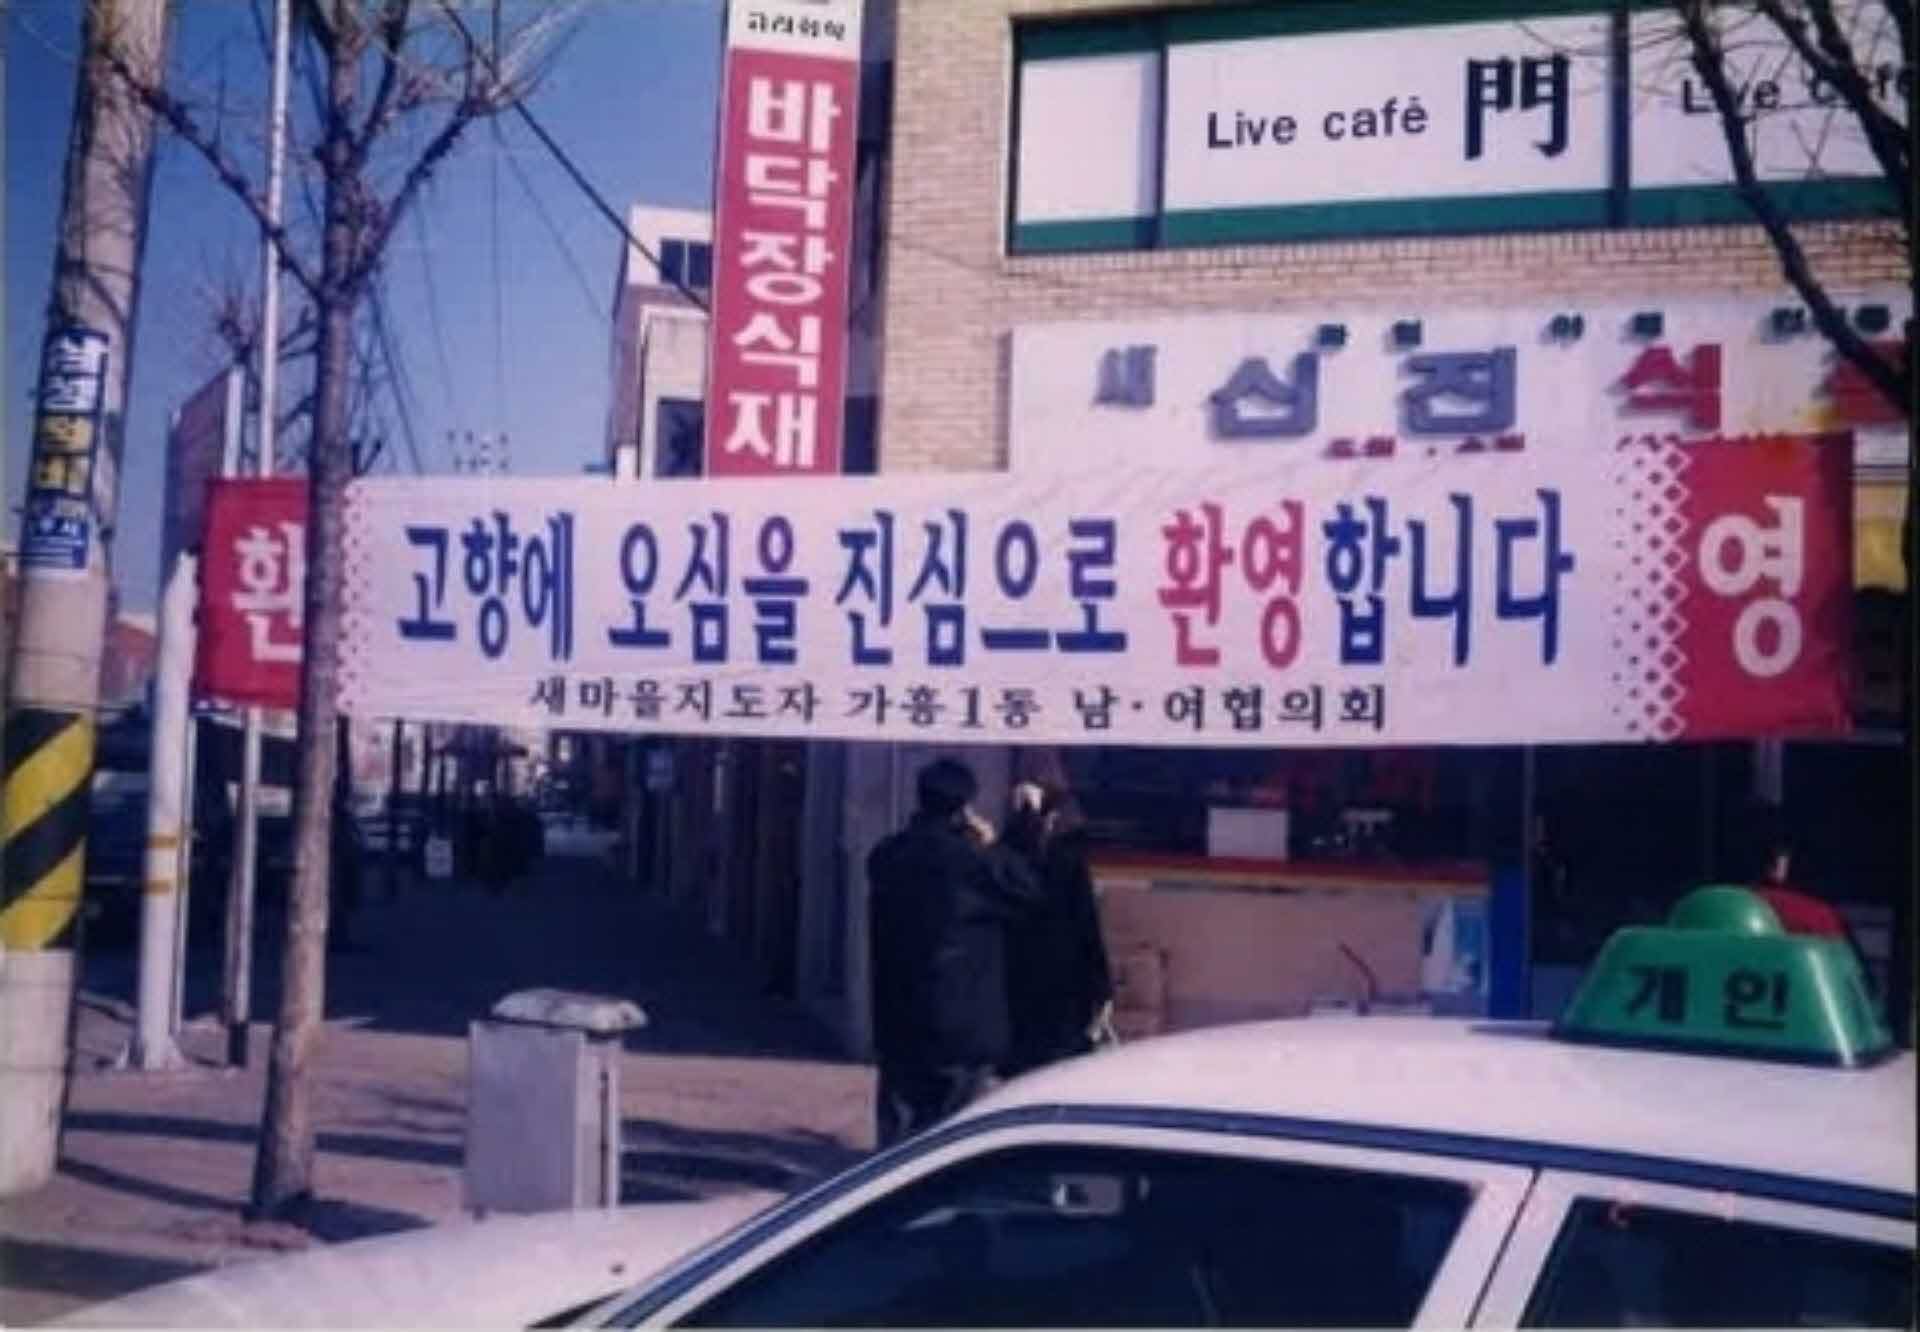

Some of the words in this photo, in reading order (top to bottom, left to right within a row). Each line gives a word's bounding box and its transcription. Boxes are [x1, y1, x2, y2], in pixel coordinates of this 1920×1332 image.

[1207, 111, 1298, 149] Live
[1463, 52, 1571, 161] 門
[725, 77, 842, 470] 바닥장식재
[231, 519, 305, 663] 환
[398, 509, 574, 662] 고향에
[607, 510, 810, 664] 오심을
[835, 507, 1128, 666] 진심으로
[1157, 488, 1575, 669] 환영합니다
[1698, 495, 1805, 678] 영
[530, 676, 820, 723] 새마을지도자
[846, 684, 1041, 731] 가흥1동
[1622, 964, 1789, 1031] 개인
